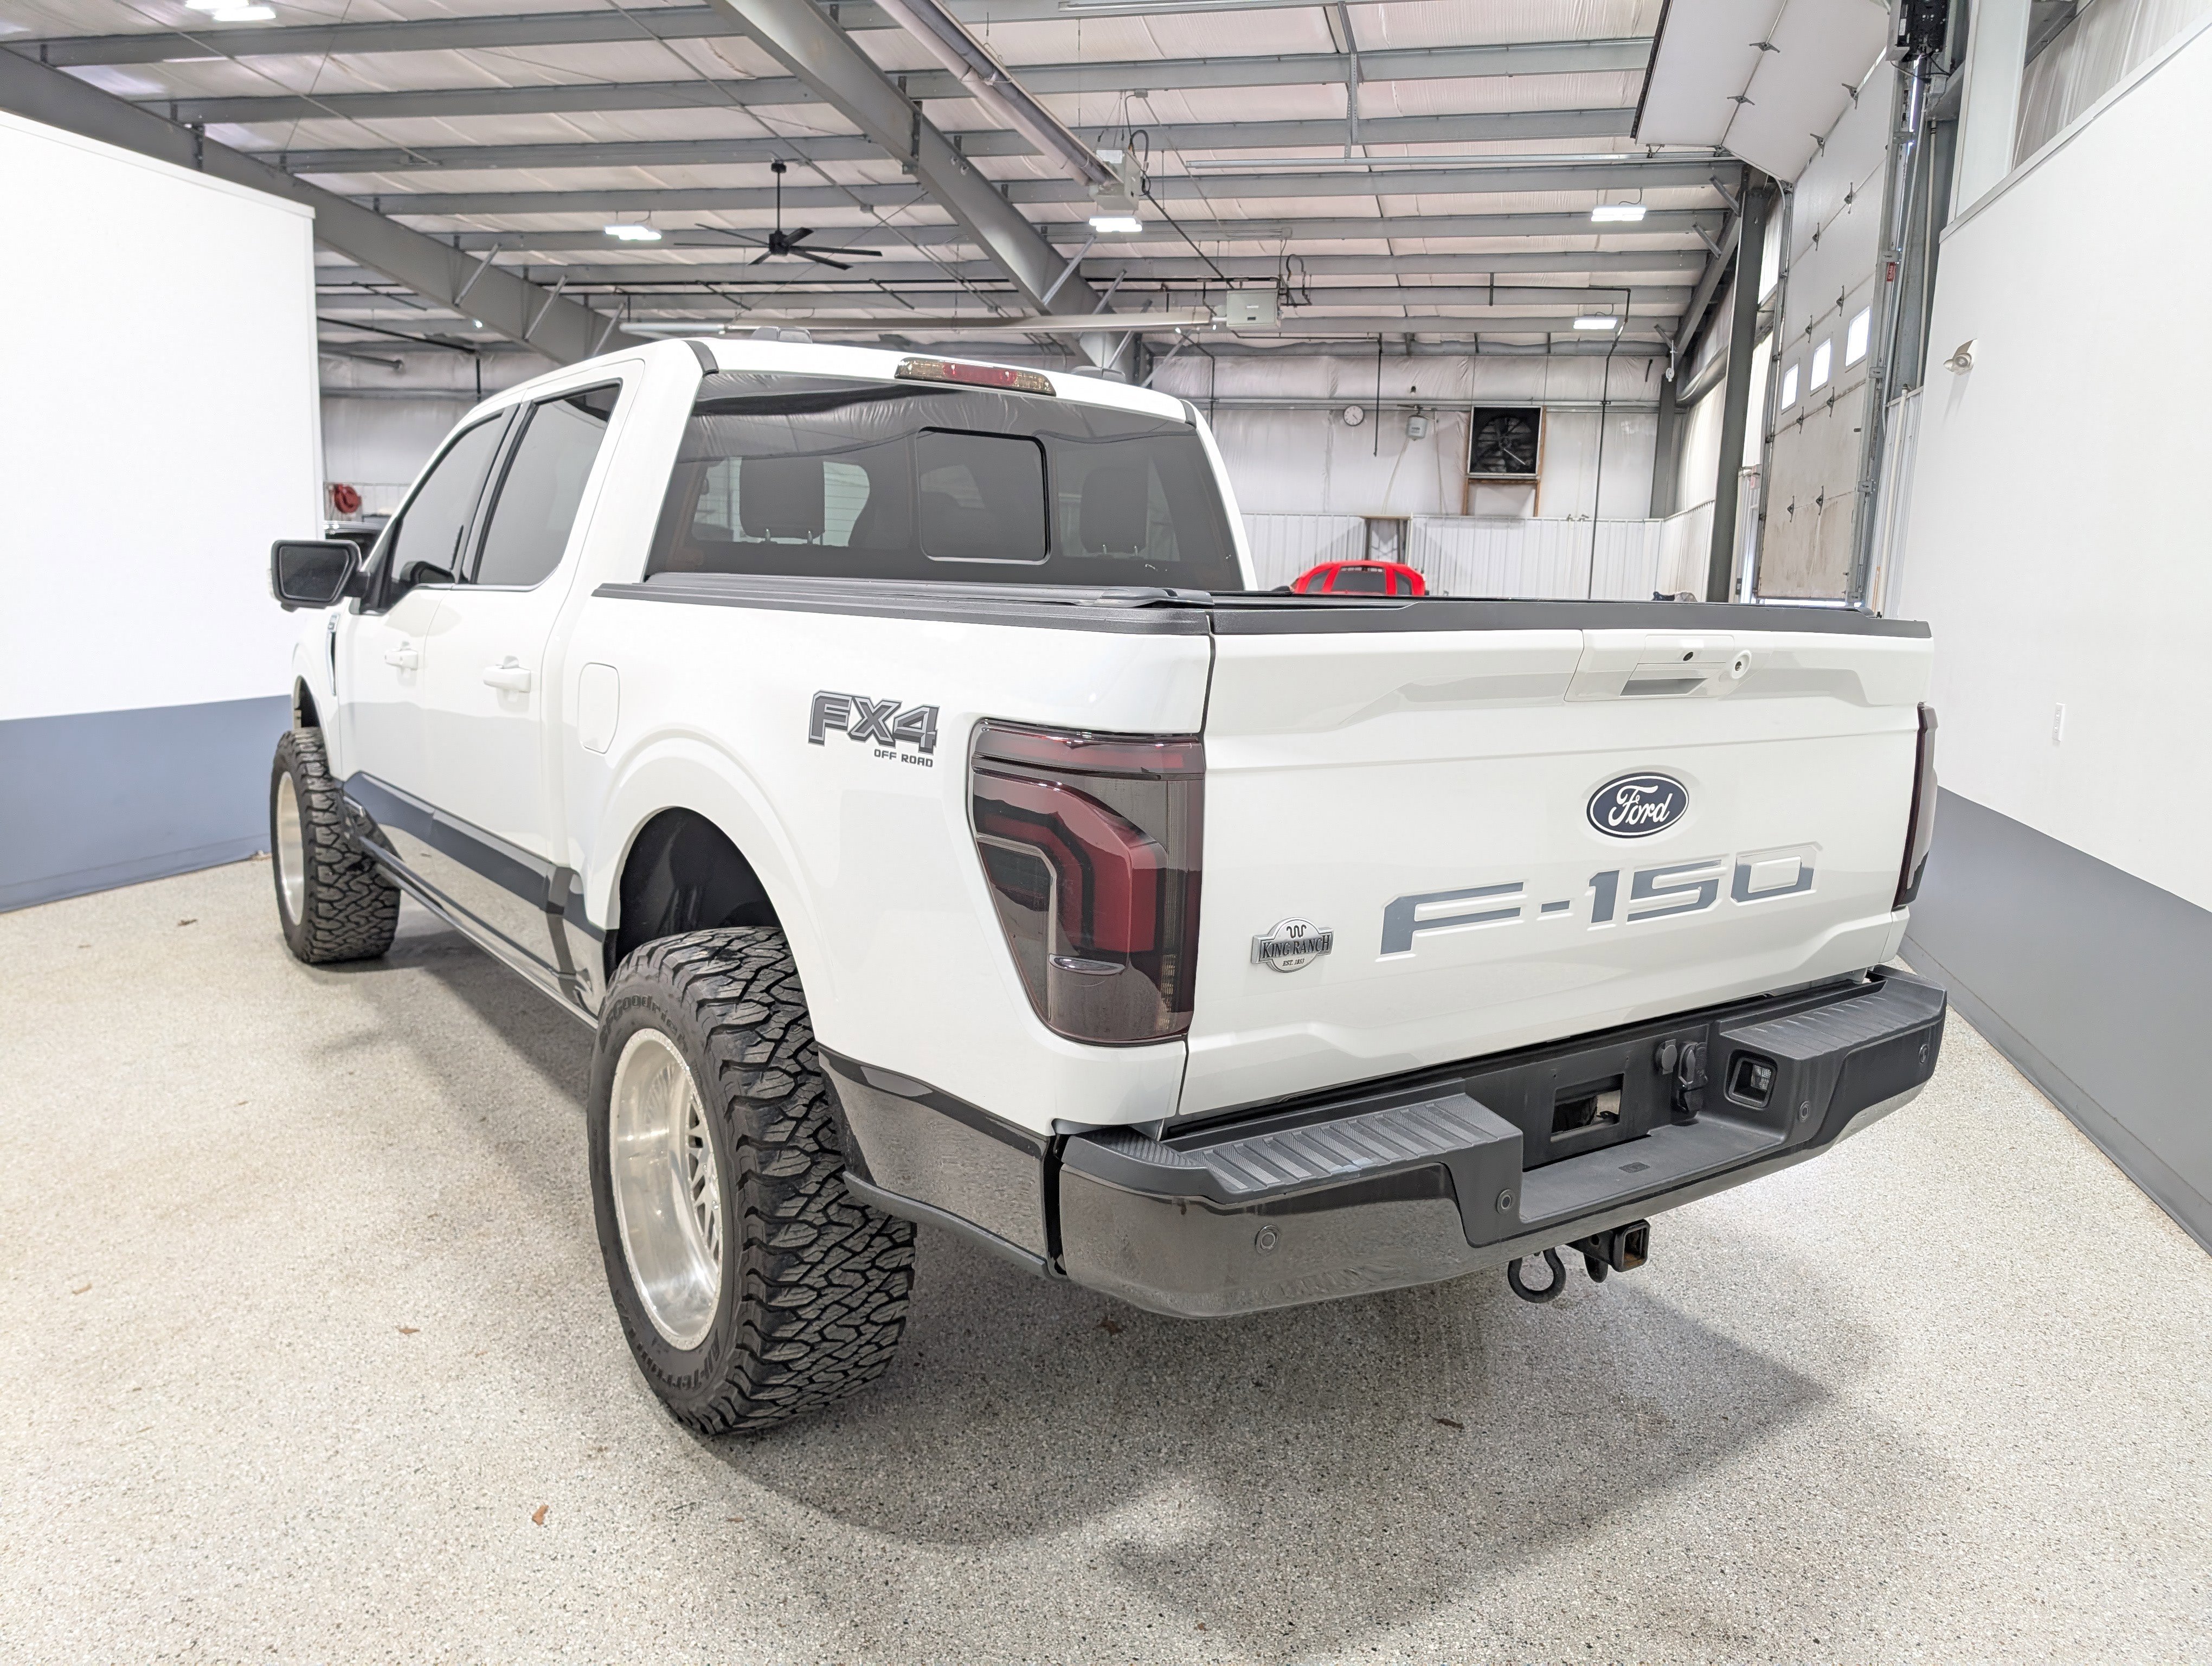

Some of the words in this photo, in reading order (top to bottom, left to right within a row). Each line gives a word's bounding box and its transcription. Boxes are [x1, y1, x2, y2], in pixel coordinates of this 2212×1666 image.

[808, 690, 941, 755] FX4
[874, 748, 897, 760] OFF
[901, 754, 933, 767] ROAD
[1608, 785, 1673, 826] Ford
[1380, 846, 1817, 955] F-150
[1263, 942, 1290, 958] KING
[1293, 935, 1330, 955] RANCH
[599, 995, 689, 1054] BFGoodrich
